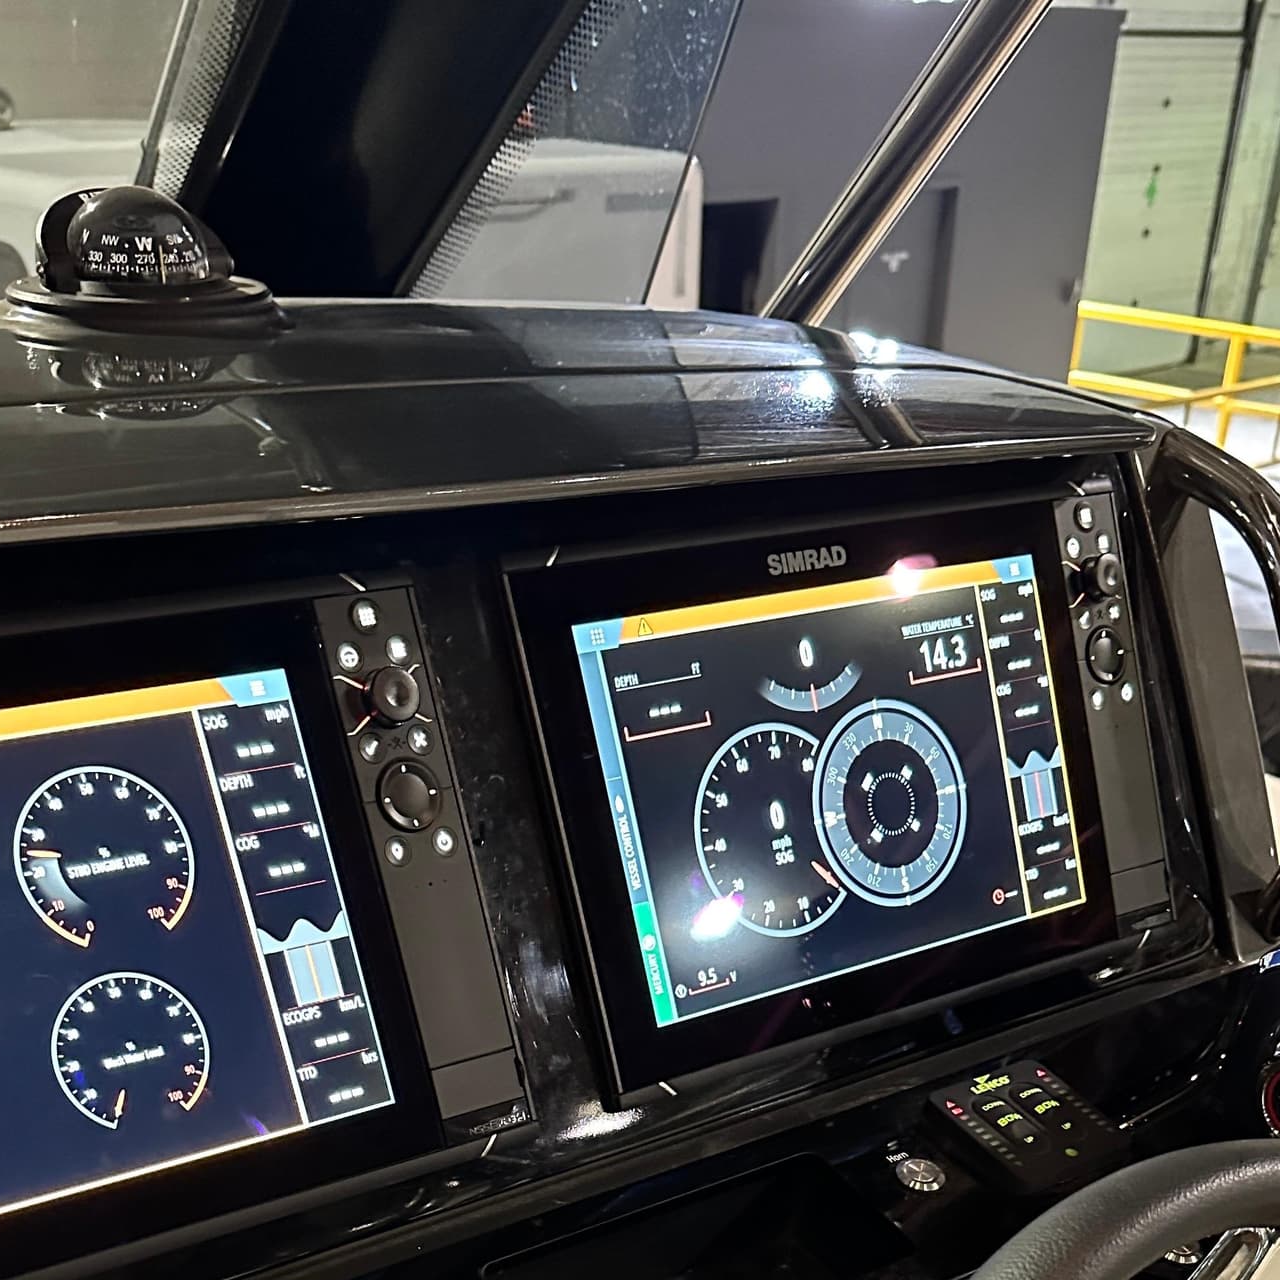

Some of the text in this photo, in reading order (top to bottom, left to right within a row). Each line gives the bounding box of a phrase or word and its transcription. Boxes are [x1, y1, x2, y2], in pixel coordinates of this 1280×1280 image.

[101, 233, 119, 246] NW
[135, 236, 153, 251] W
[88, 250, 156, 265] 330 300 270
[767, 545, 847, 577] SIMRAD
[980, 587, 997, 602] SOG
[797, 638, 815, 669] 0
[919, 634, 968, 673] 14.3
[614, 673, 639, 689] DEPTH
[202, 704, 290, 731] SOG mph
[903, 722, 914, 735] 30
[841, 732, 858, 751] 330
[768, 745, 782, 760] 70
[929, 746, 941, 760] 60
[735, 757, 750, 773] 60
[219, 774, 254, 792] DEPTH
[826, 766, 839, 787] 300
[715, 793, 729, 808] 50
[769, 800, 786, 831] 0
[943, 823, 953, 840] 120
[235, 835, 261, 852] COG
[713, 837, 727, 852] 40
[771, 834, 793, 853] mph
[618, 814, 642, 891] VESSEL CONTROL
[775, 850, 796, 866] SOG
[840, 848, 855, 867] 240
[66, 853, 151, 879] STBD ENGINE LEVEL
[925, 858, 939, 873] 150
[165, 877, 179, 890] 90
[732, 877, 745, 893] 30
[867, 873, 882, 888] 210
[51, 900, 65, 913] 10
[763, 900, 776, 914] 20
[797, 896, 810, 910] 10
[147, 906, 165, 920] 100
[86, 920, 95, 933] 0
[697, 967, 737, 987] 9.5 V
[184, 1064, 196, 1076] 90
[297, 1065, 319, 1081] TTD
[970, 1074, 1010, 1095] LENCO
[167, 1089, 184, 1102] 100
[1034, 1100, 1060, 1114] BOW
[997, 1113, 1023, 1127] BOW
[885, 1152, 909, 1163] Horn
